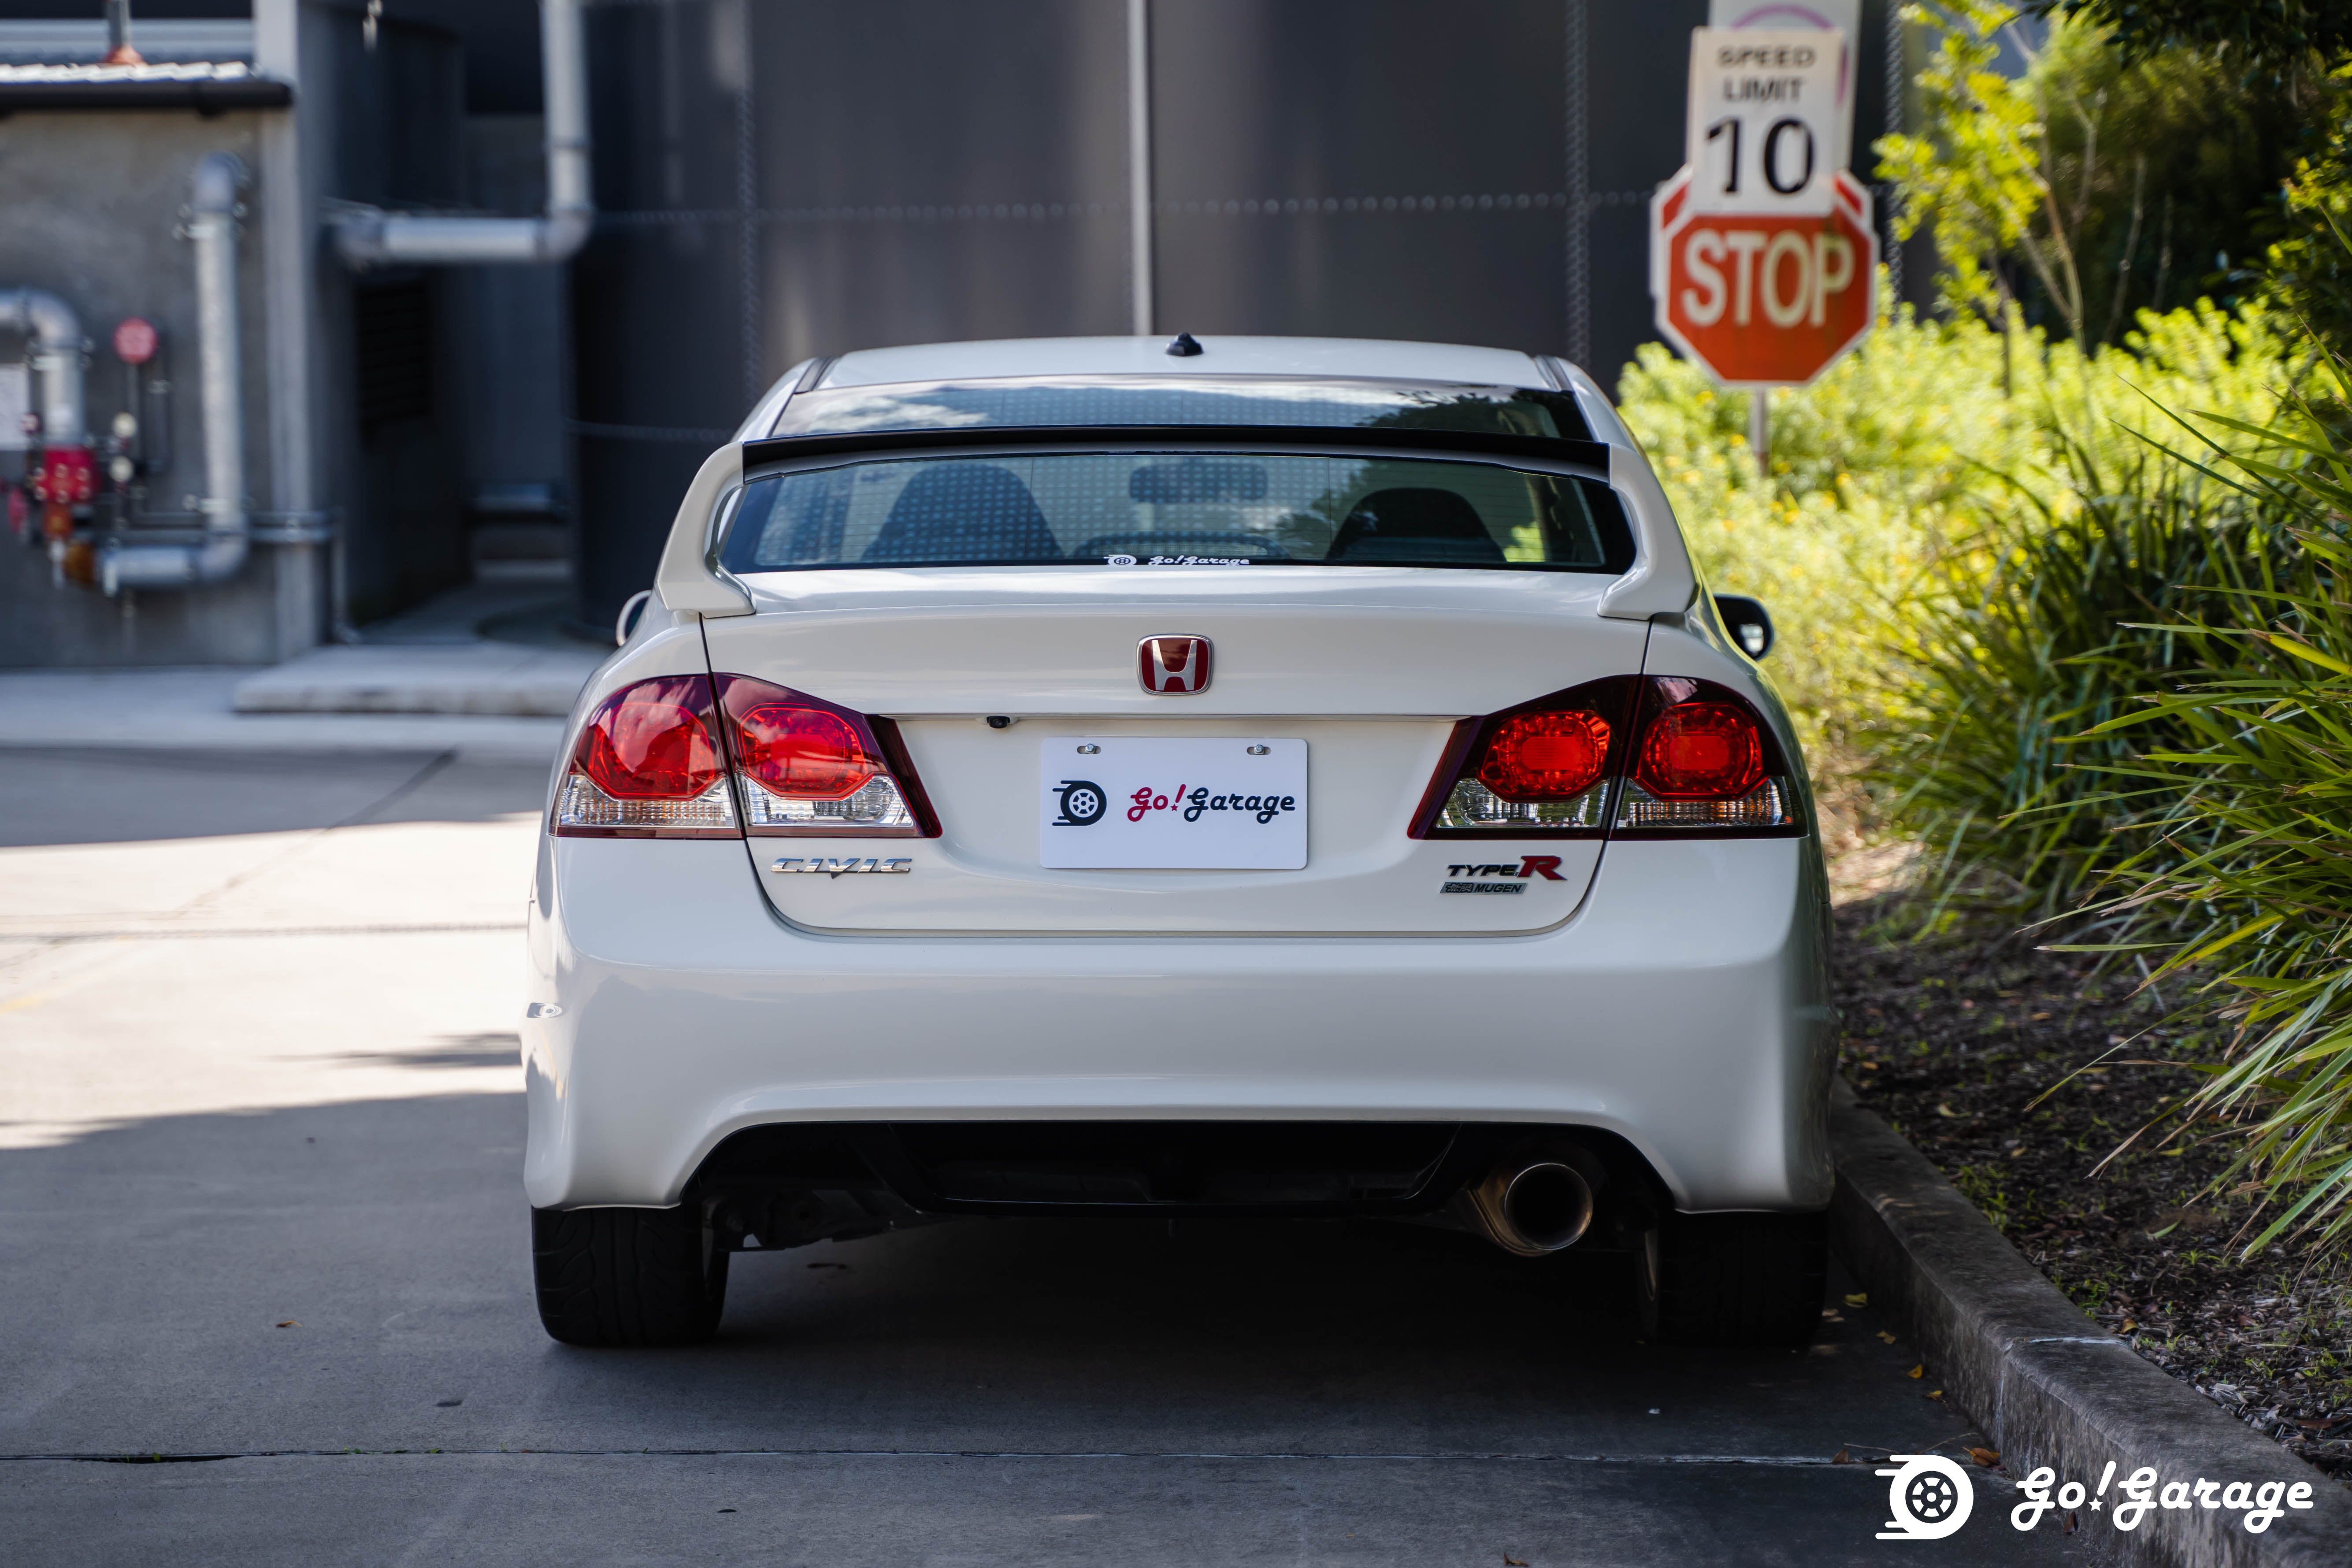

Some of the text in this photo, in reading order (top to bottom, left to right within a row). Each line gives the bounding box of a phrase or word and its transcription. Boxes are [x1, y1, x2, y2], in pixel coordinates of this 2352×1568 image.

[1718, 45, 1816, 67] SPEED
[1722, 76, 1803, 102] LIMIT
[1707, 114, 1815, 196] 10
[1681, 228, 1855, 328] STOP
[771, 858, 913, 879] CIVIC
[1474, 884, 1523, 893] MUGEN
